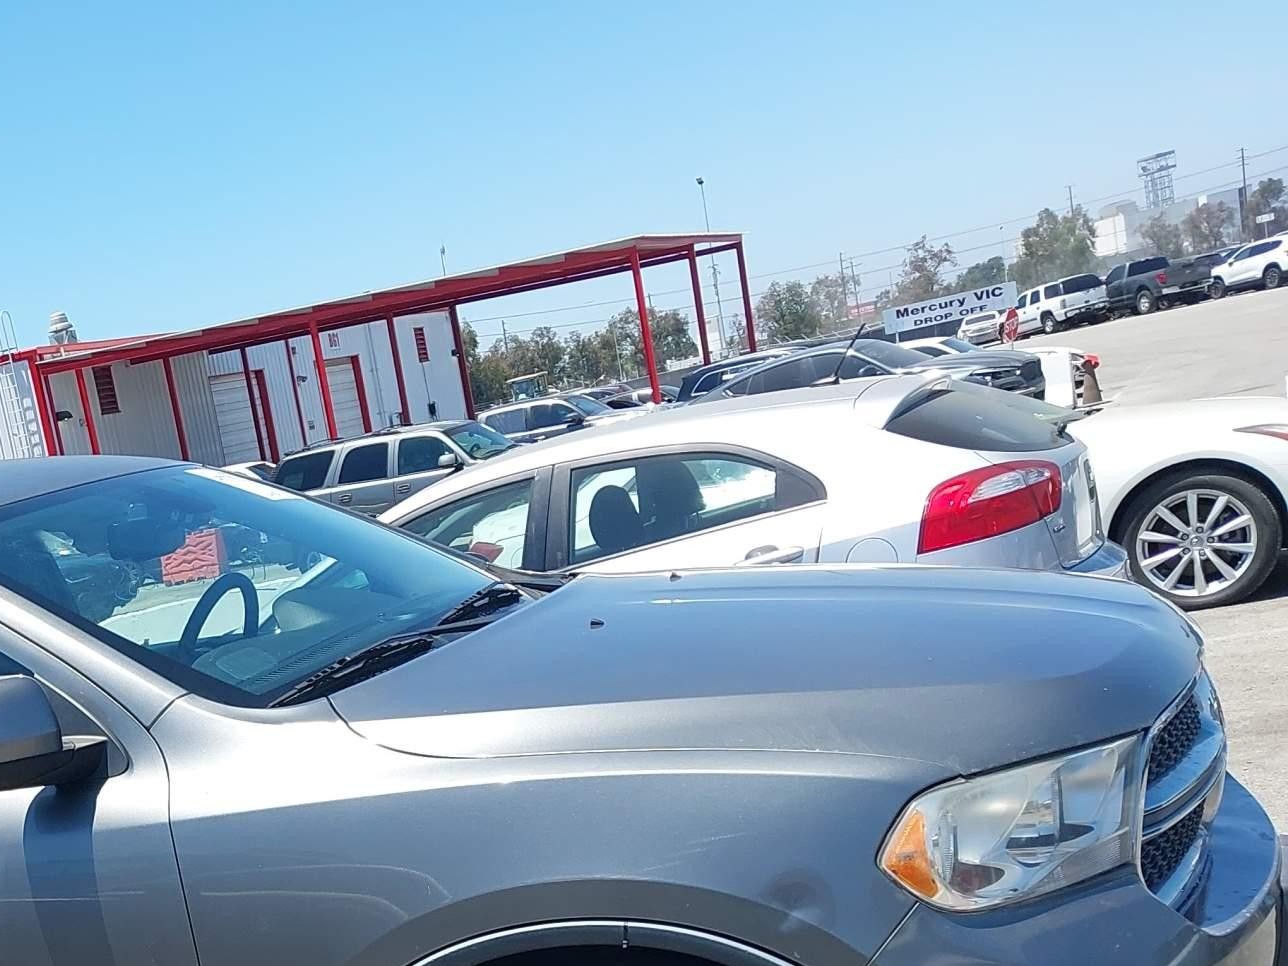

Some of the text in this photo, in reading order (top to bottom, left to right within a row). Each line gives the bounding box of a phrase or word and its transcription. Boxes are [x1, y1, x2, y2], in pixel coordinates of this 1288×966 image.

[895, 297, 966, 319] Mercury
[973, 286, 1003, 301] VIC
[913, 304, 988, 327] DROP OFF
